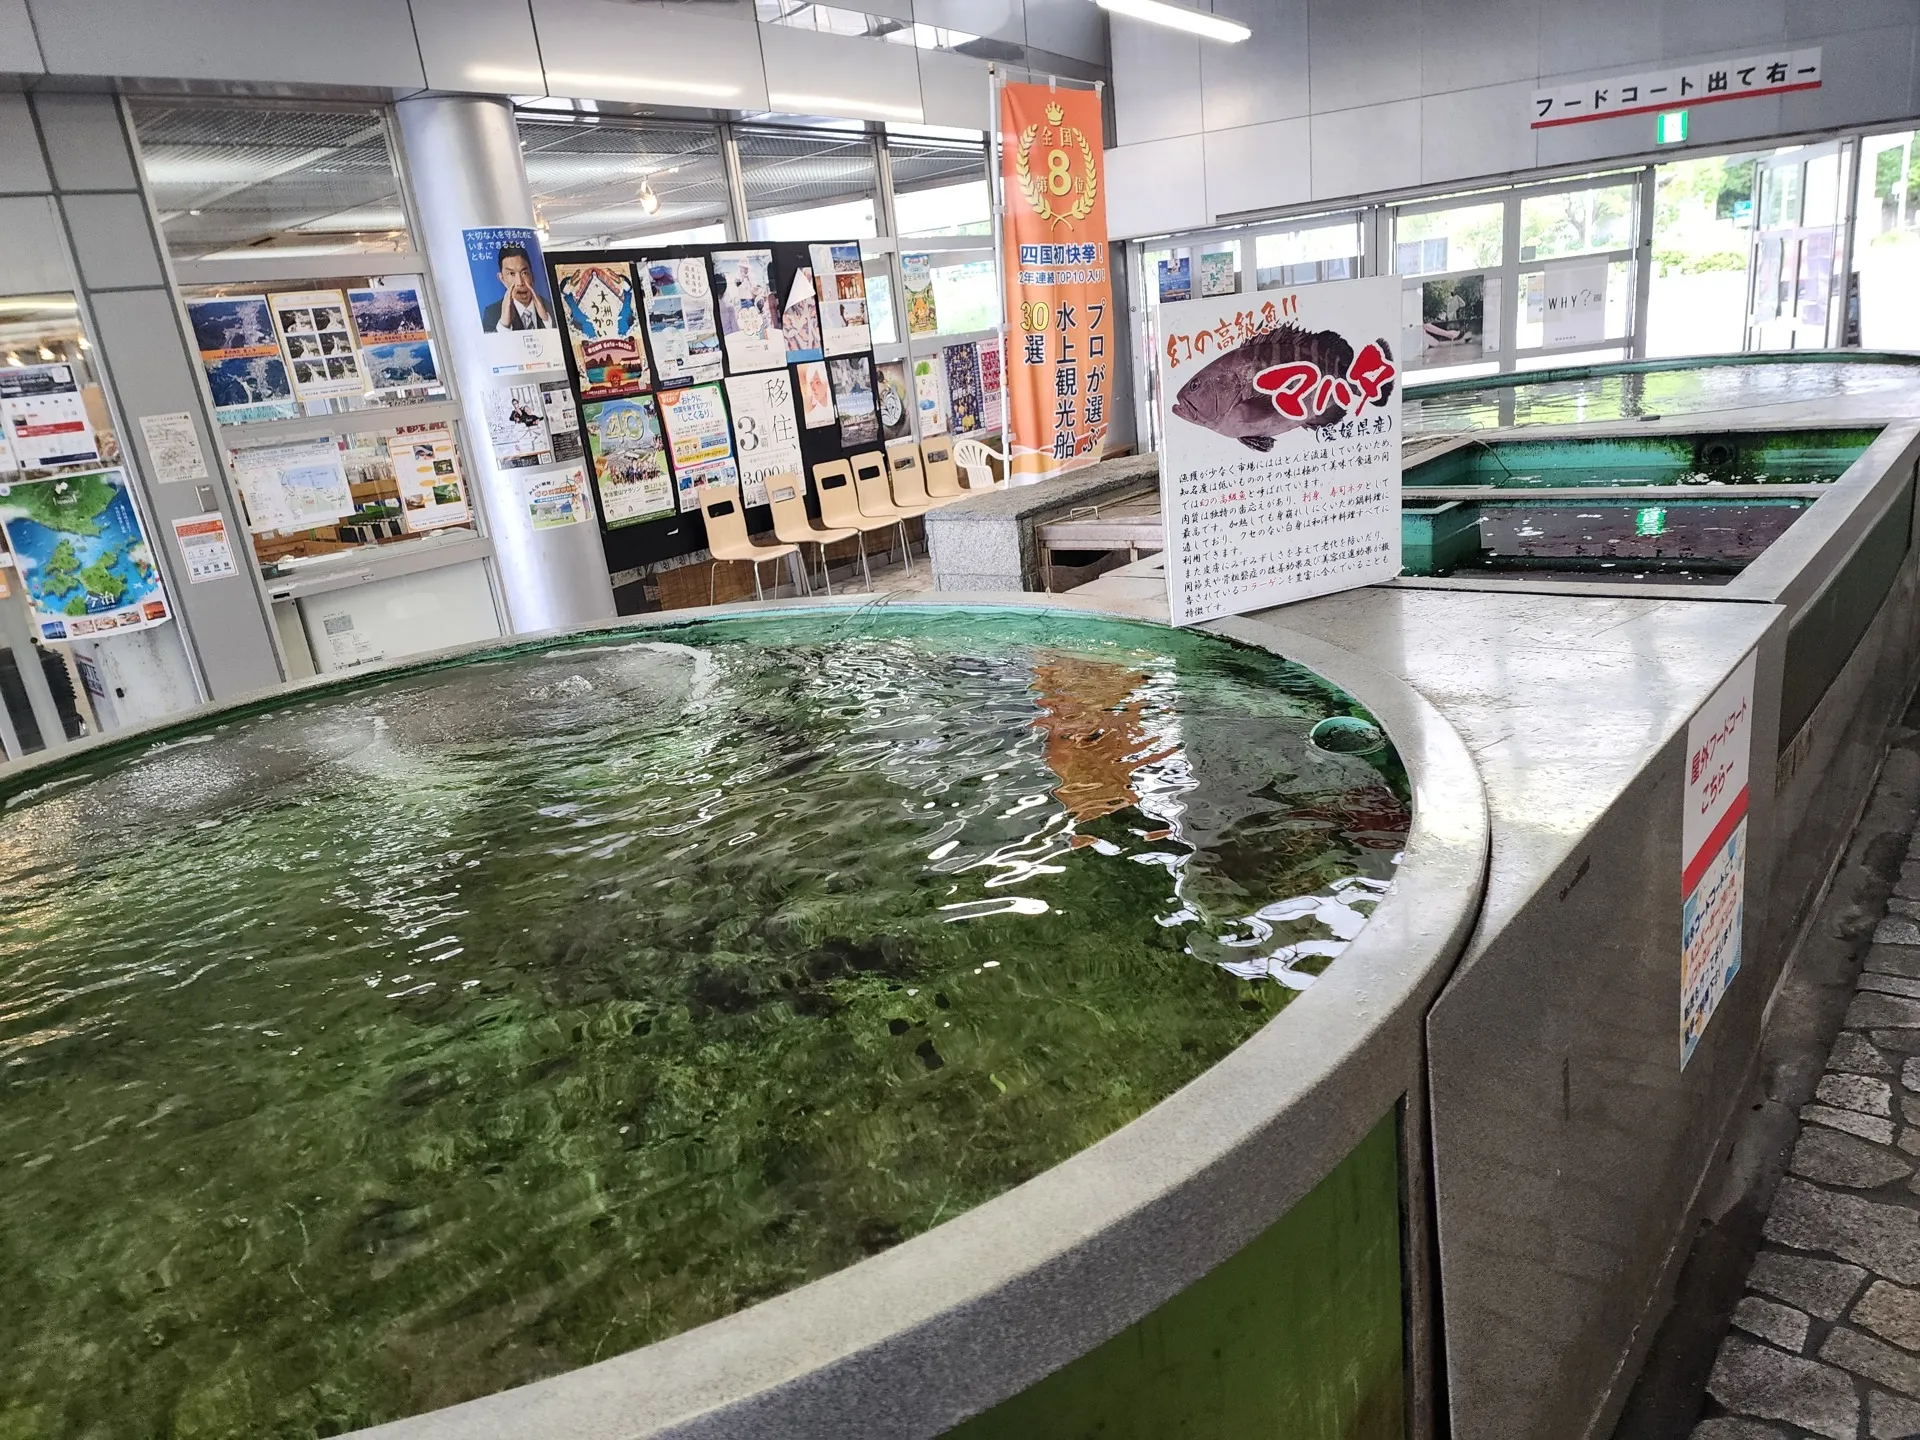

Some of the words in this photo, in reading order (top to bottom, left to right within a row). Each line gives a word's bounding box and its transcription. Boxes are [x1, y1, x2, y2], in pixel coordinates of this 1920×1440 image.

[1042, 126, 1073, 147] 全国
[466, 230, 532, 241] 大切な人を守るために
[471, 252, 494, 261] ともに
[1548, 289, 1592, 310] WHY?
[1020, 301, 1050, 365] 30選
[1053, 301, 1078, 460] 水上観光船
[1082, 298, 1107, 454] プロが選ぶ
[1252, 344, 1395, 420] マハタ
[1183, 546, 1243, 565] 利用できます。
